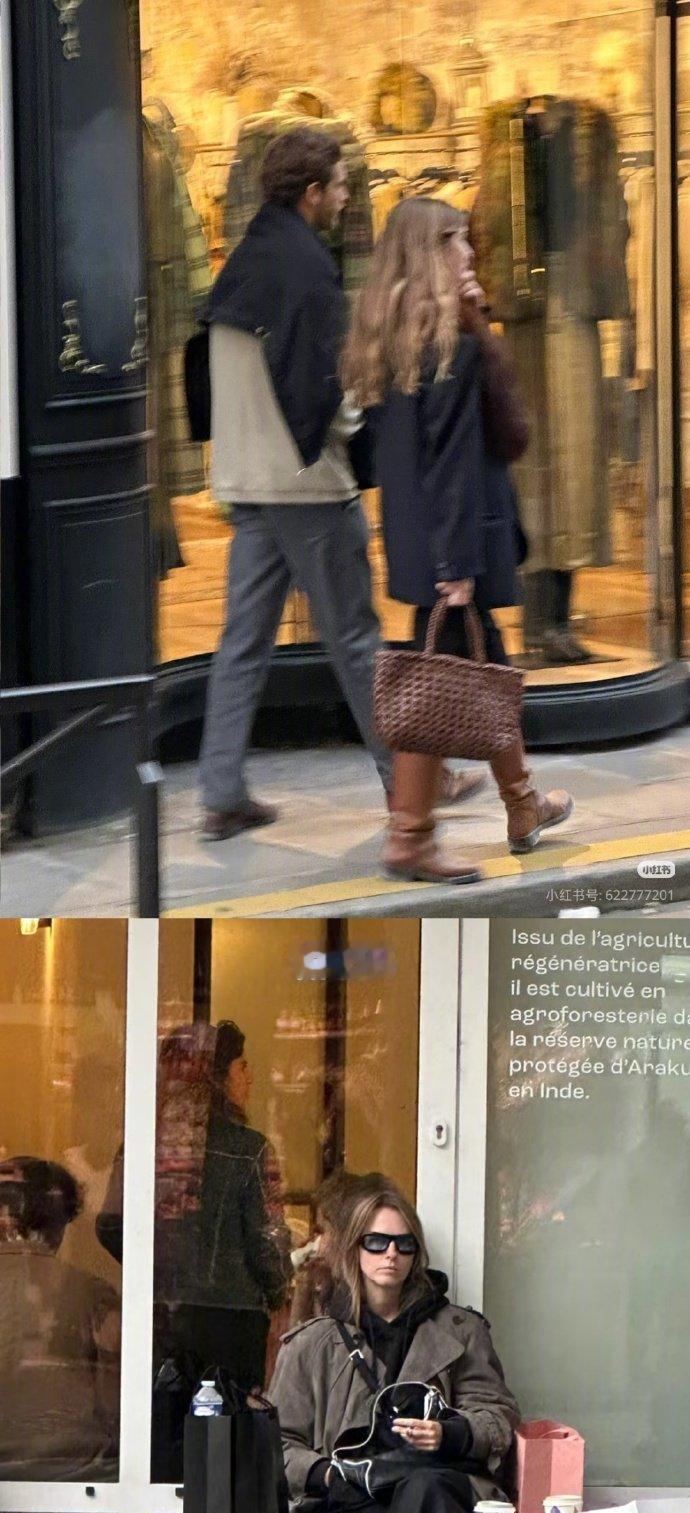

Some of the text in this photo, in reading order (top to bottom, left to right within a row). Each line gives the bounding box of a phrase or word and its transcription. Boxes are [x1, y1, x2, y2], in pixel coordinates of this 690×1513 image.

[512, 928, 555, 945] Issu
[560, 929, 586, 946] de
[511, 954, 660, 975] régénératrice
[510, 979, 666, 999] il est cultivé en
[510, 1005, 667, 1026] agroforesterie
[509, 1030, 527, 1047] la
[509, 1057, 605, 1078] protégée
[508, 1082, 590, 1100] en Inde.
